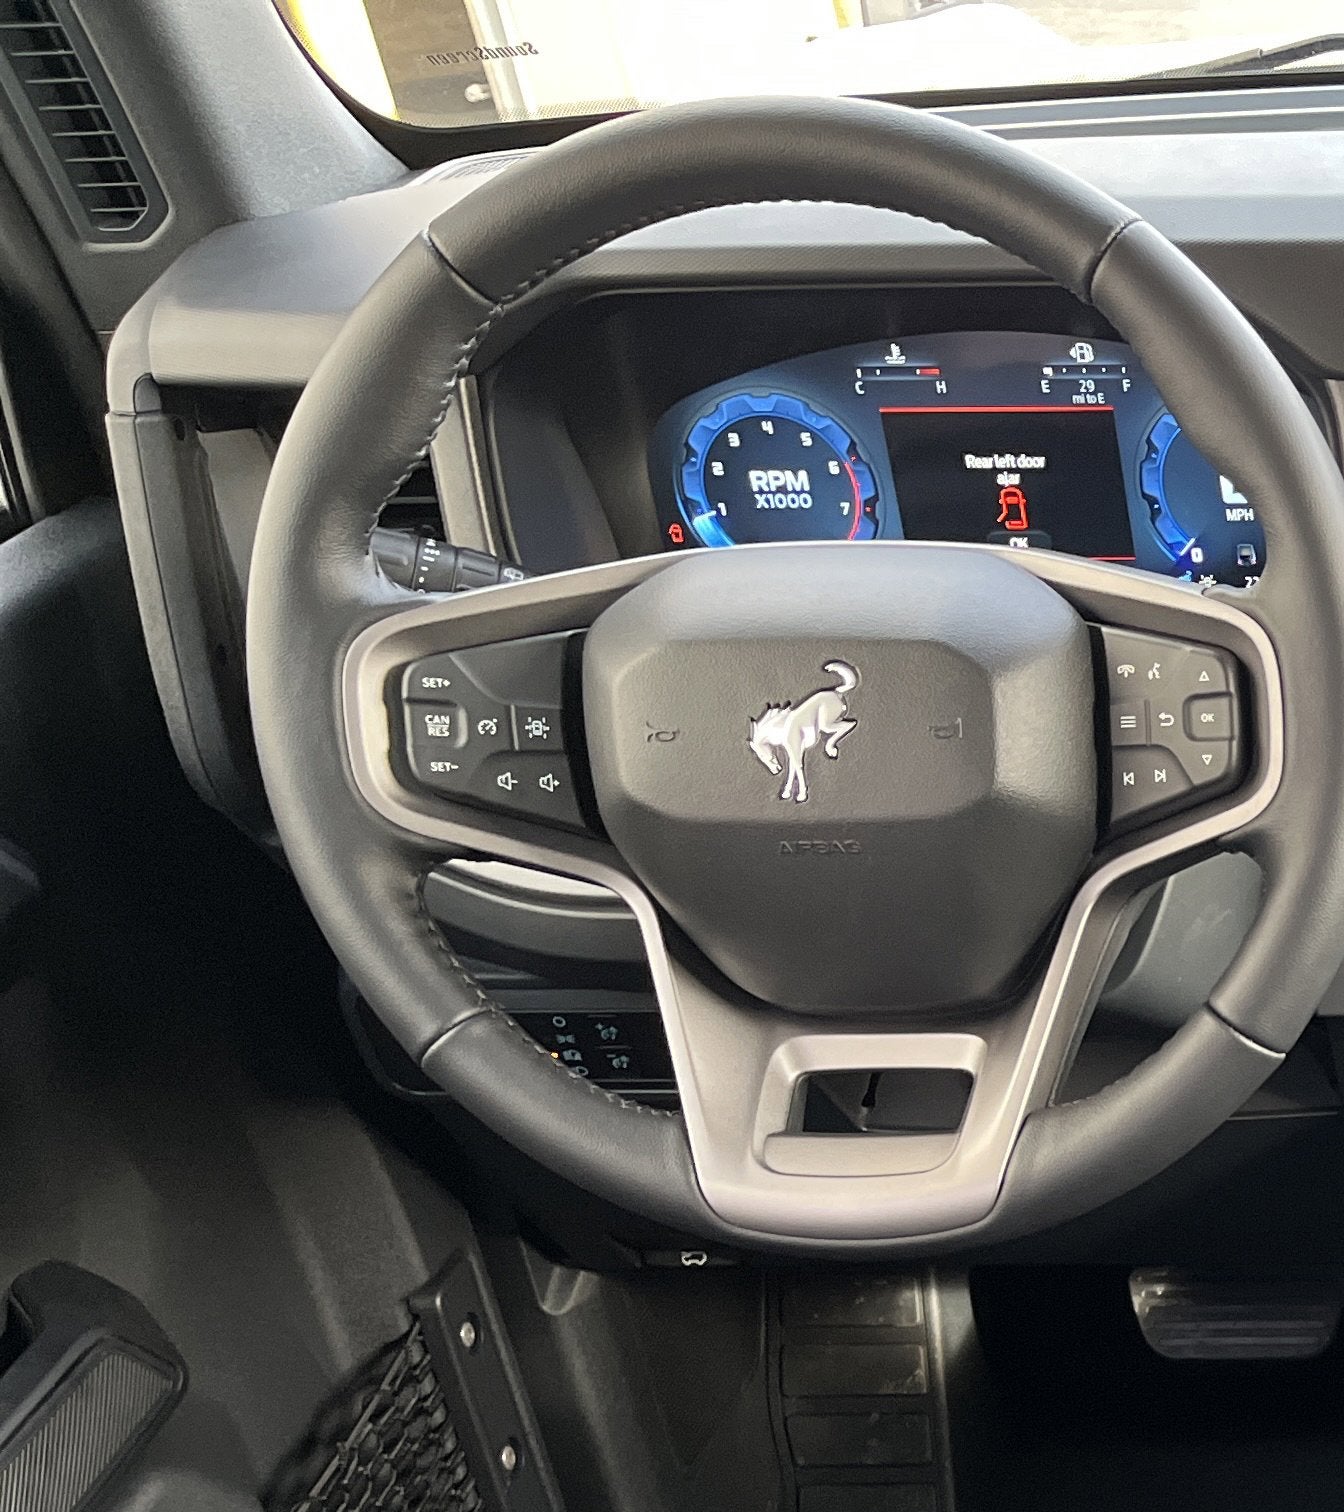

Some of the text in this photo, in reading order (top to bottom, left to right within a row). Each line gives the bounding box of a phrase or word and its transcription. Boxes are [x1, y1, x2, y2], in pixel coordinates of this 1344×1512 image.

[855, 381, 947, 394] C H
[1041, 379, 1131, 393] E 29 F
[761, 420, 774, 435] 4
[727, 432, 813, 448] 3 5
[711, 460, 841, 476] 2 6
[964, 453, 1046, 469] Rear left door
[750, 469, 810, 492] RPM
[997, 470, 1021, 487] ajar
[717, 501, 850, 516] 1 7
[1225, 508, 1255, 522] MPH
[1009, 536, 1029, 548] OK
[1190, 547, 1203, 563] 0
[424, 714, 451, 725] CAN
[1200, 712, 1215, 723] OK
[427, 726, 451, 738] RES
